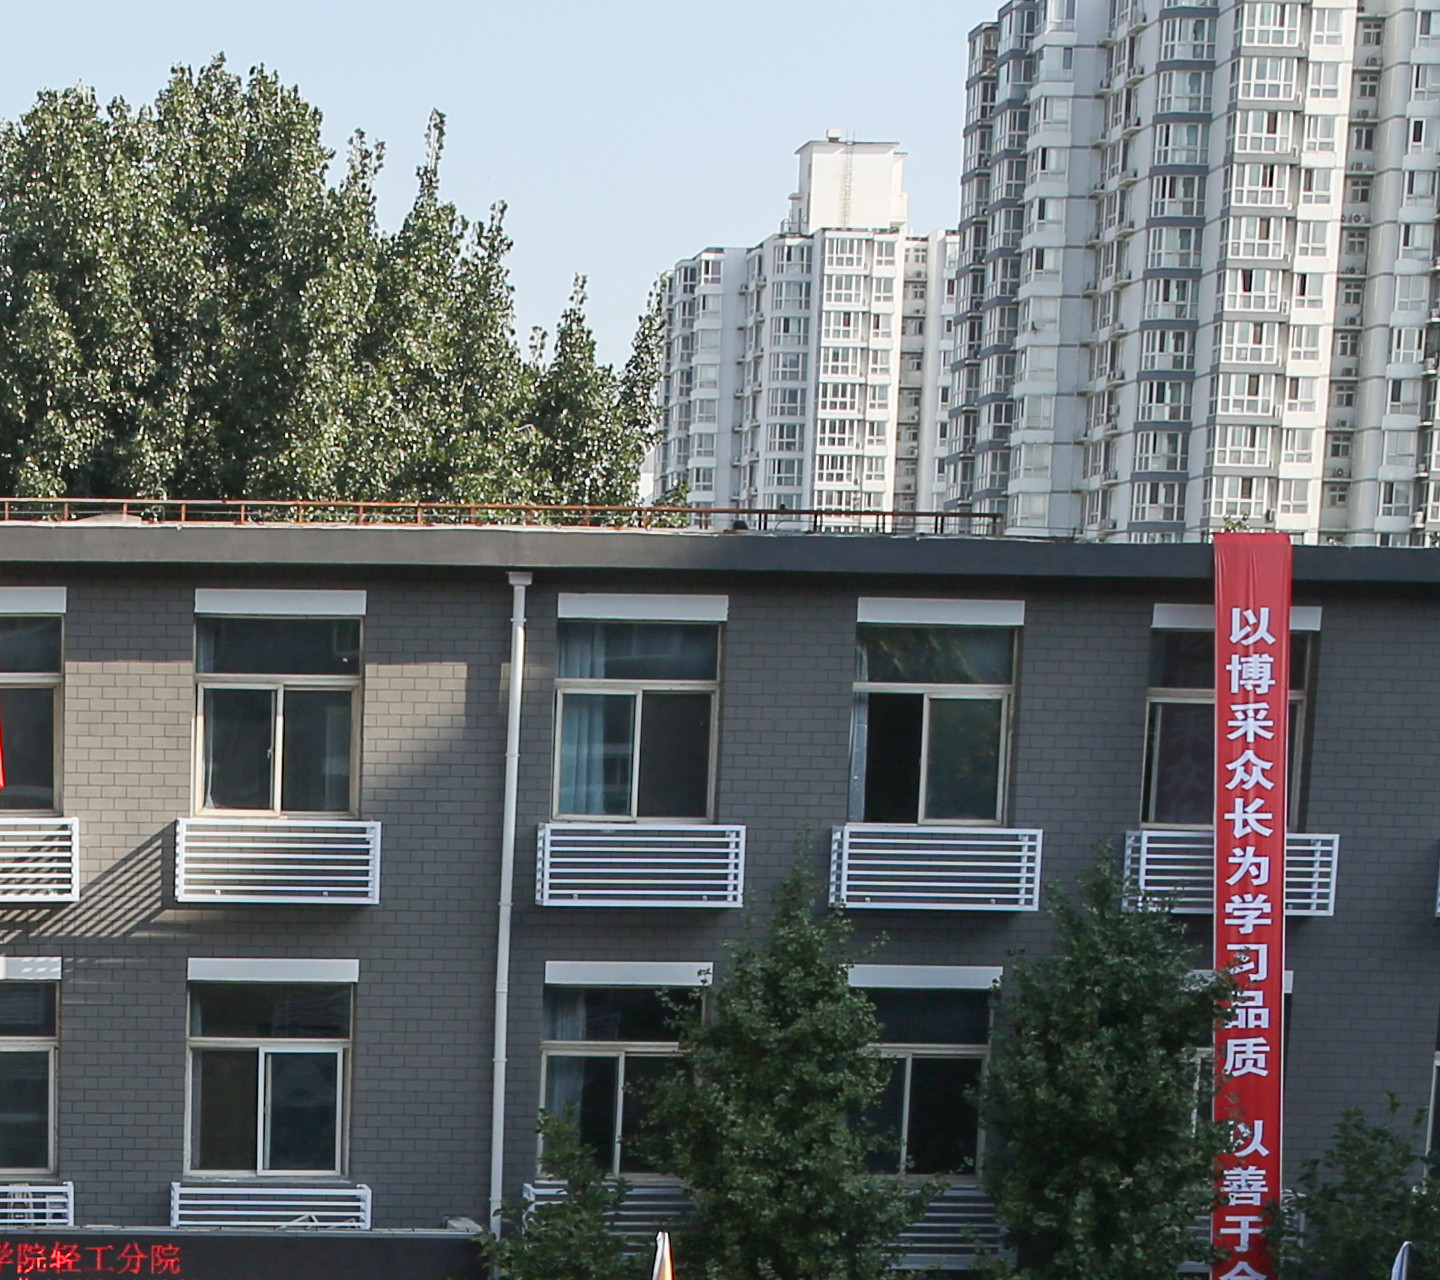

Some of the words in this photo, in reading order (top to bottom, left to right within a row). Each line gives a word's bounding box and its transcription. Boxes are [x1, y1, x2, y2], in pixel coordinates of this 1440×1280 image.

[1223, 606, 1276, 1077] 以博采众长为学习品质
